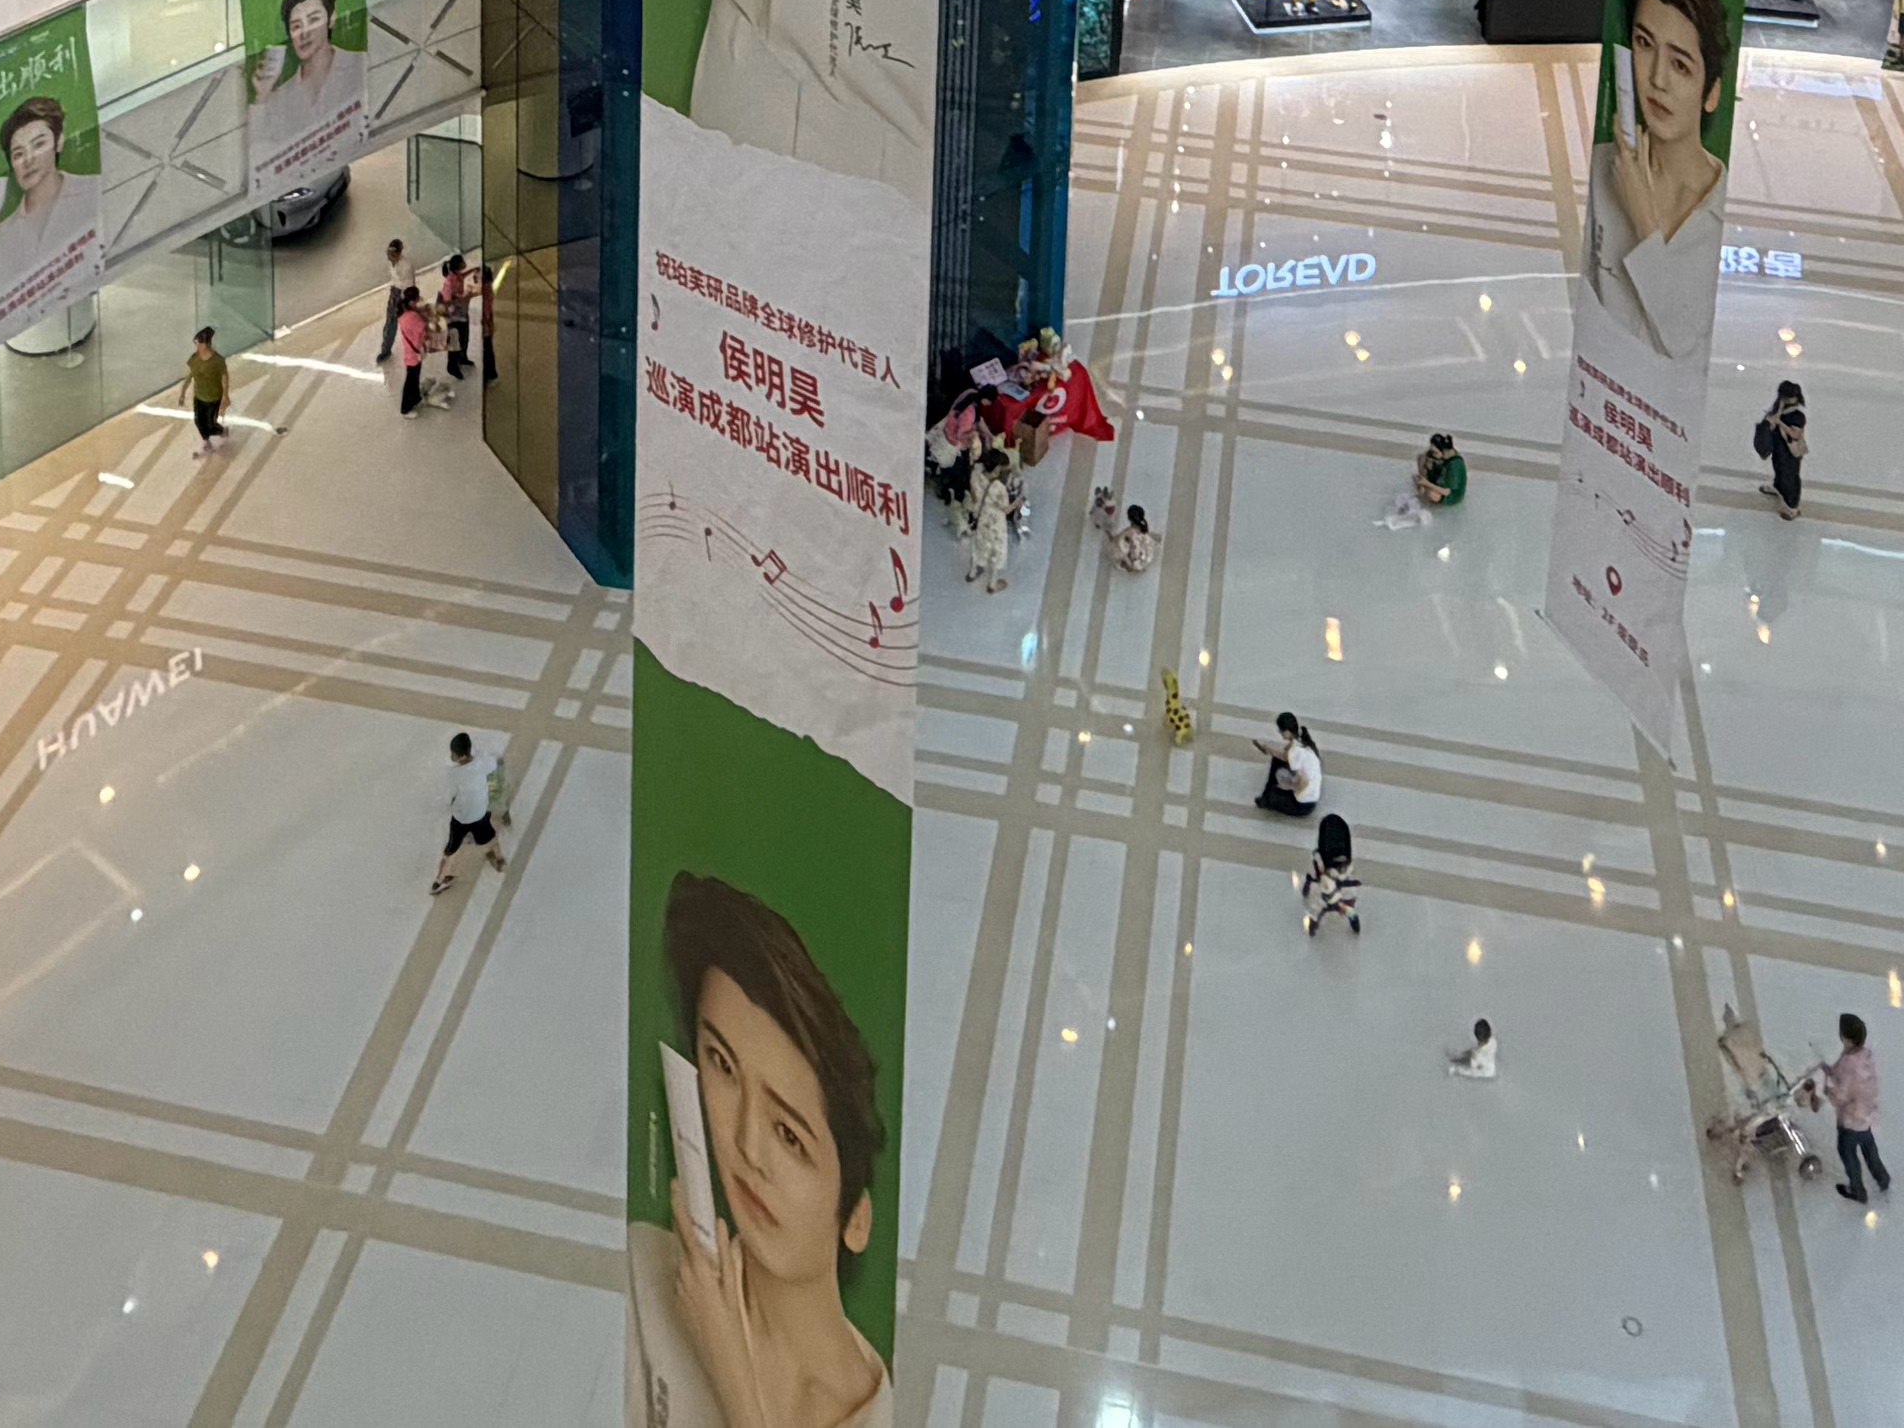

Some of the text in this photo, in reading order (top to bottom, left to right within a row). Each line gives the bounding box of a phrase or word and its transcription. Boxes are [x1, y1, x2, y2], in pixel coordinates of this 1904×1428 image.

[654, 248, 901, 391] 祝珀芙研品牌全球修护代言人
[717, 329, 827, 430] 侯明昊
[644, 355, 913, 538] 巡演成都站演出顺利
